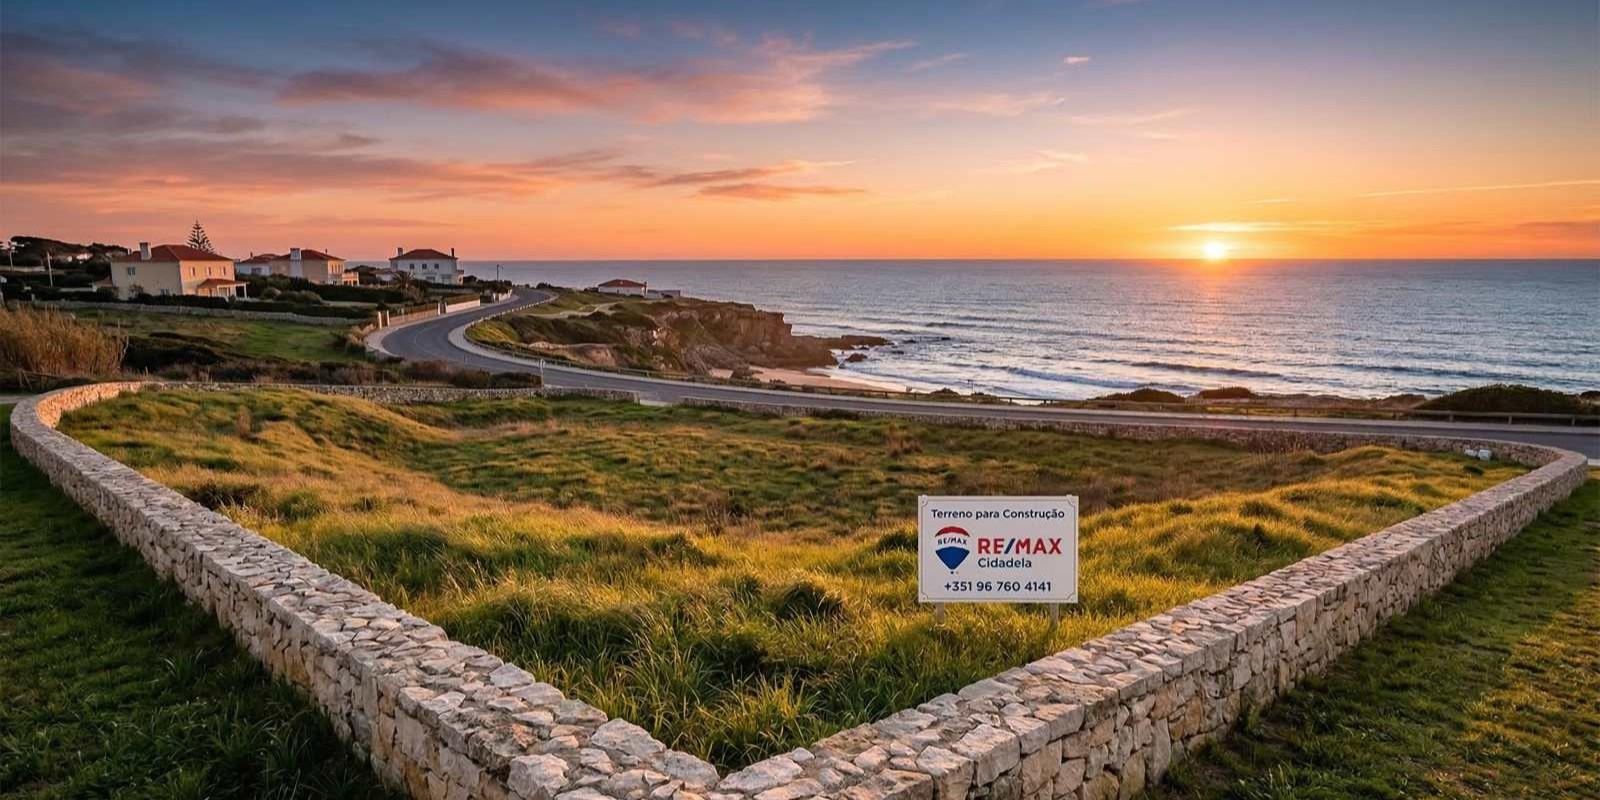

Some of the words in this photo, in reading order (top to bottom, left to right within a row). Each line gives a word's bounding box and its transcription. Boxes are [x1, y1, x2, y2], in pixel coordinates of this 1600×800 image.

[931, 509, 973, 519] Terreno
[976, 511, 1000, 520] para
[1002, 509, 1065, 520] Construção
[937, 537, 968, 546] RE/MAX
[977, 538, 1062, 555] RE/MAX
[978, 558, 1032, 568] Cidadela
[944, 581, 972, 591] +351
[976, 581, 992, 591] 96
[996, 581, 1021, 591] 760
[1024, 581, 1051, 591] 4141
